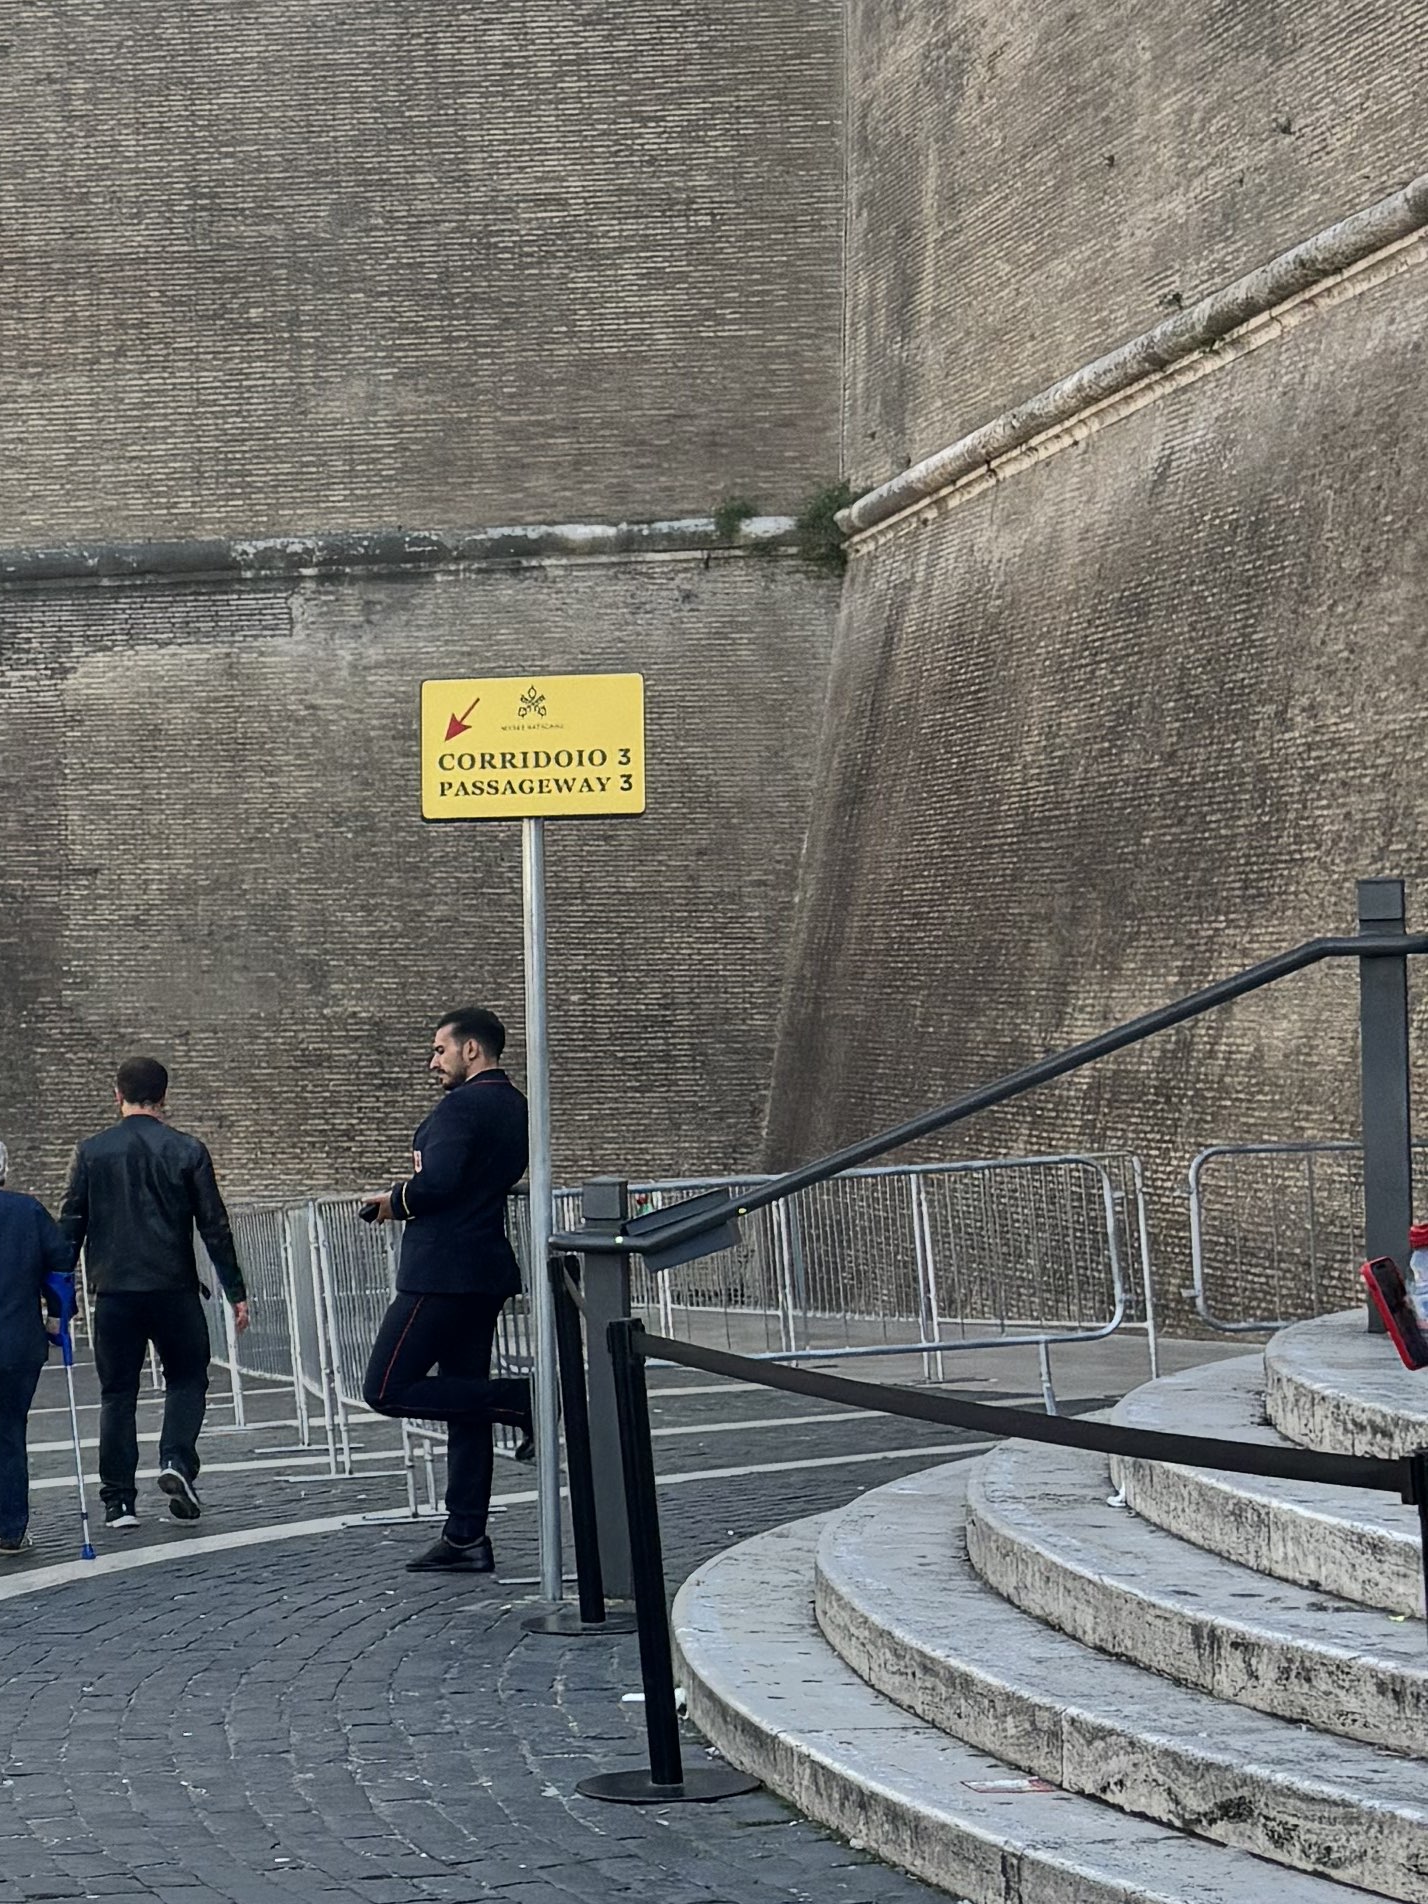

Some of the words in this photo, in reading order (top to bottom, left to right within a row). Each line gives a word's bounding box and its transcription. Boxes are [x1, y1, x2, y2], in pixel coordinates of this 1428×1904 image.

[438, 748, 608, 772] CORRIDOIO
[618, 748, 631, 766] 3
[439, 776, 612, 797] PASSAGEWAY
[620, 774, 633, 792] 3
